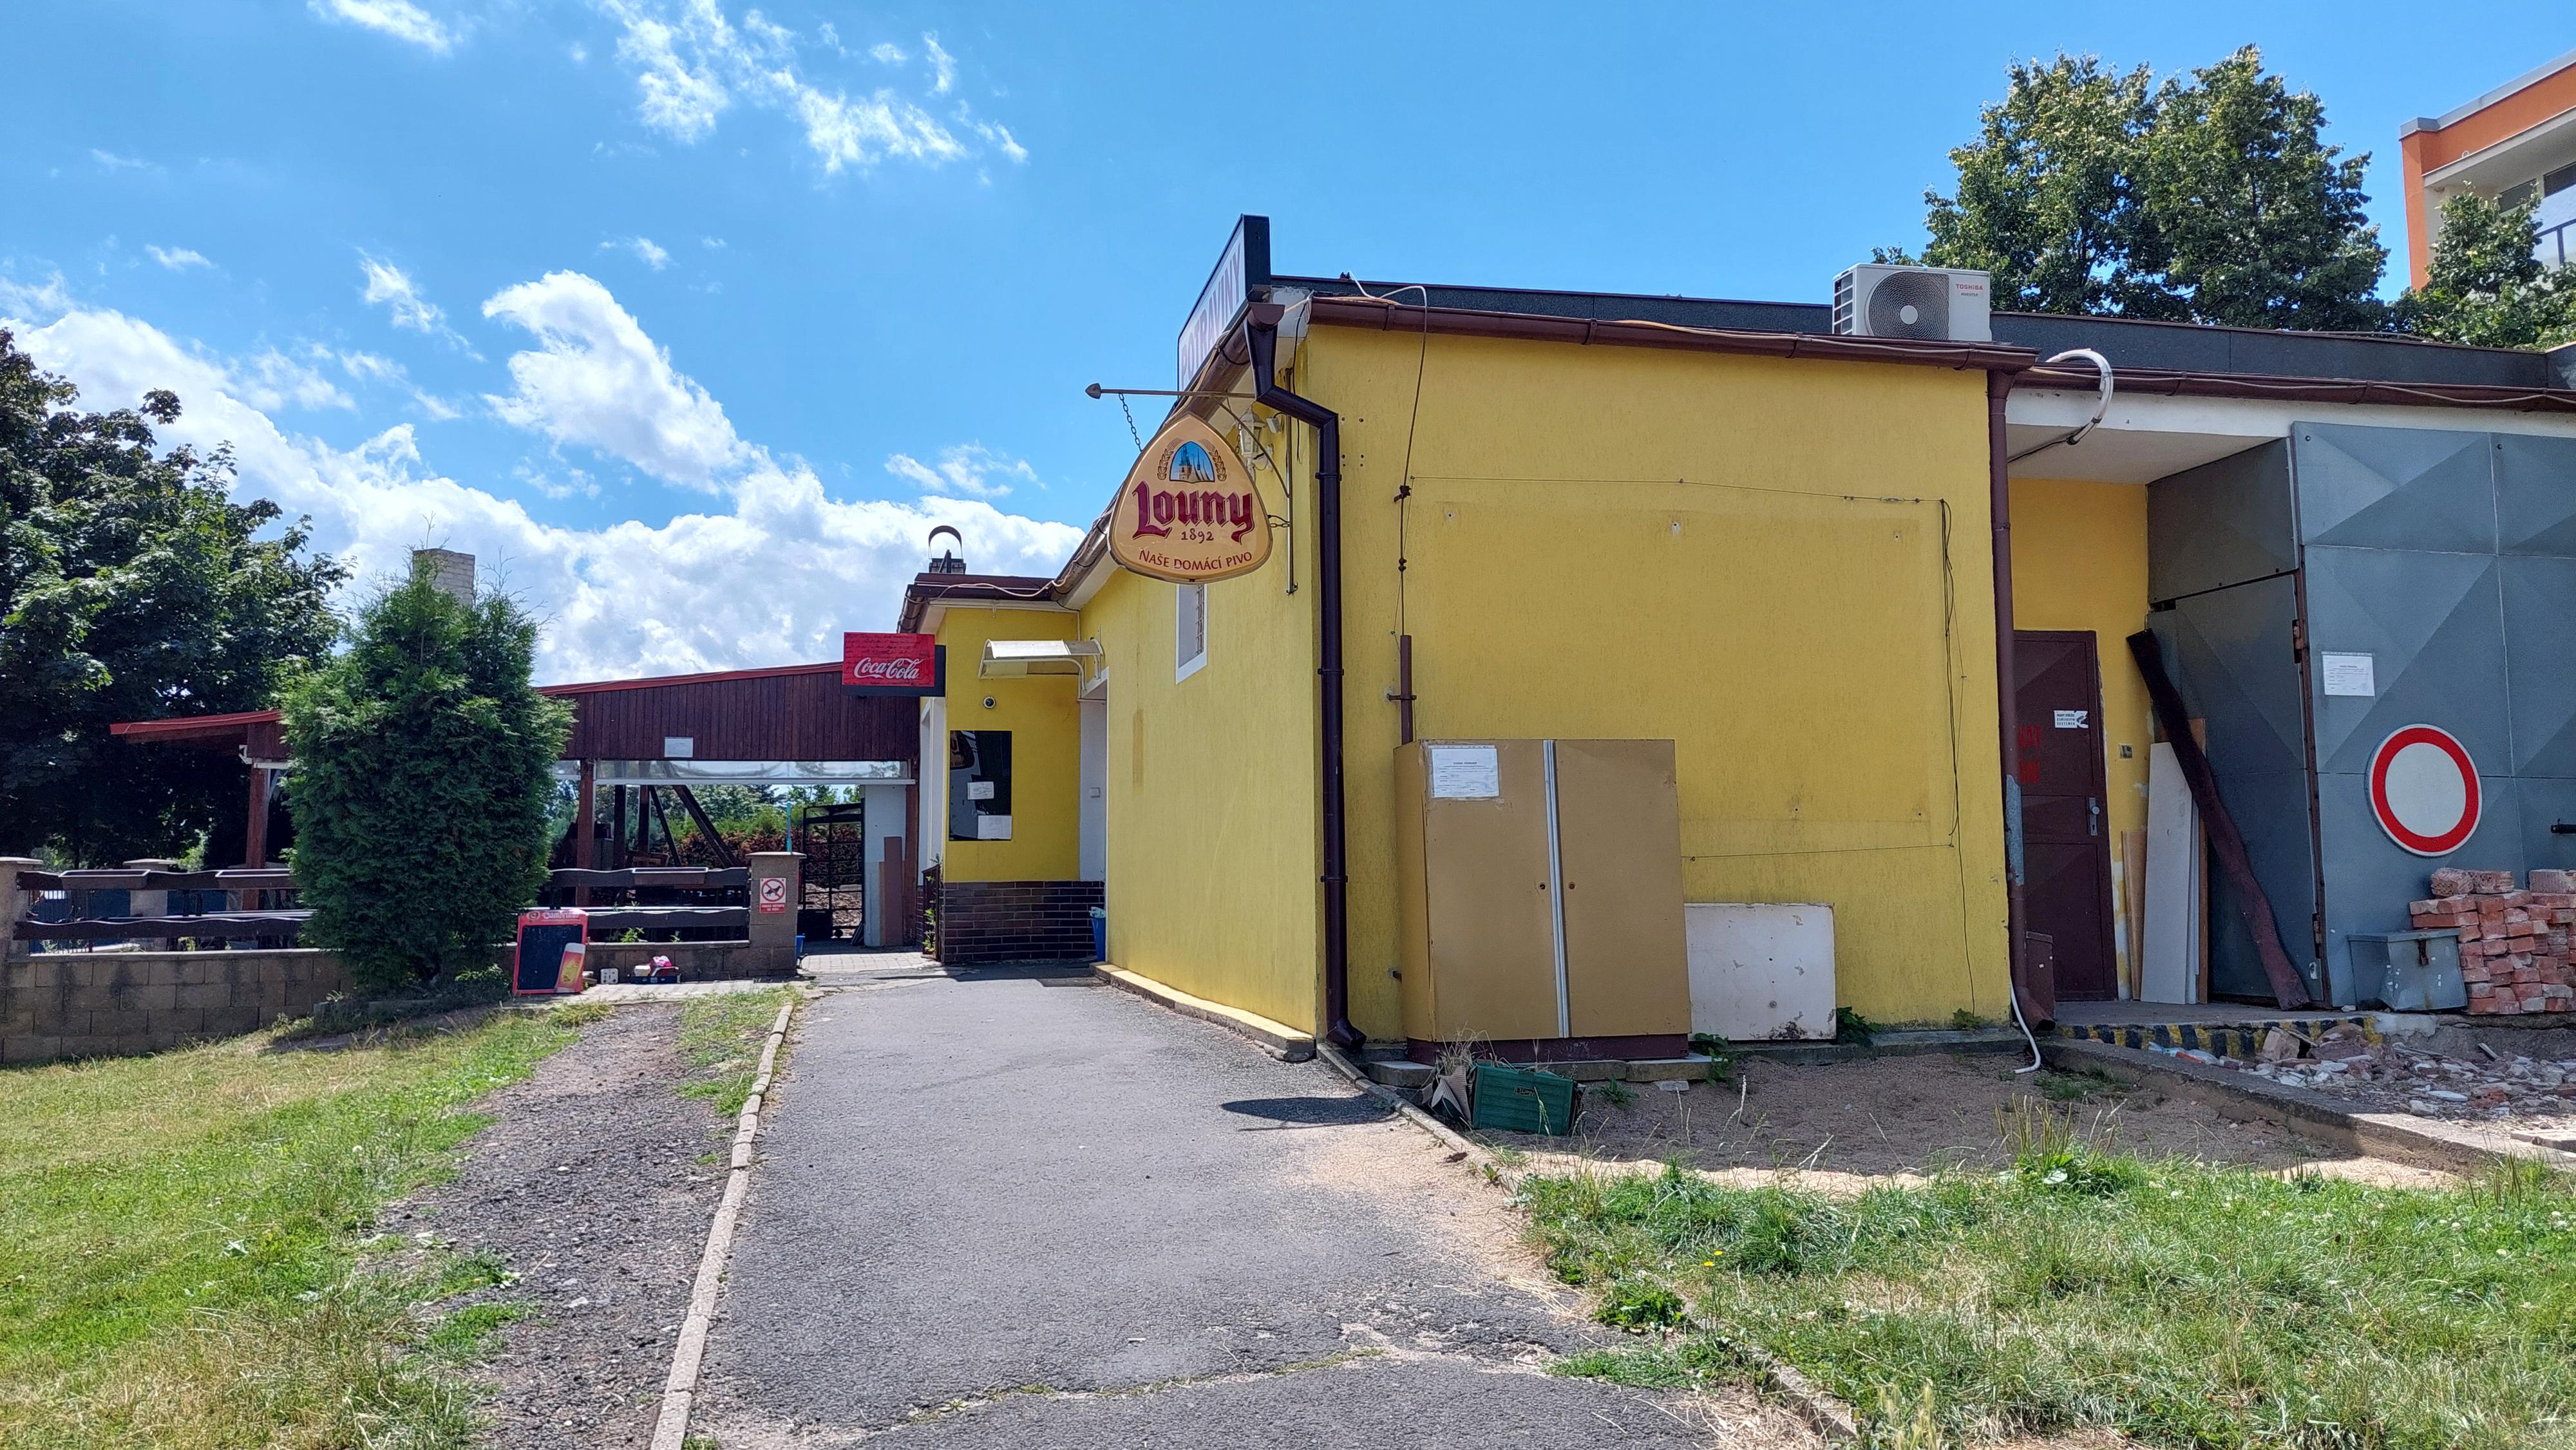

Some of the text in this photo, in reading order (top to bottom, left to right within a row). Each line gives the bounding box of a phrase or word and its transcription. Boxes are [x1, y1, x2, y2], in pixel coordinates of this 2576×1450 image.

[1181, 243, 1241, 391] POTRAVINY
[1132, 481, 1255, 544] Louny
[1181, 528, 1215, 543] 1892
[1139, 549, 1253, 570] NAŠE DOMÁCÍ PIVO
[854, 657, 923, 679] Coca-Cola
